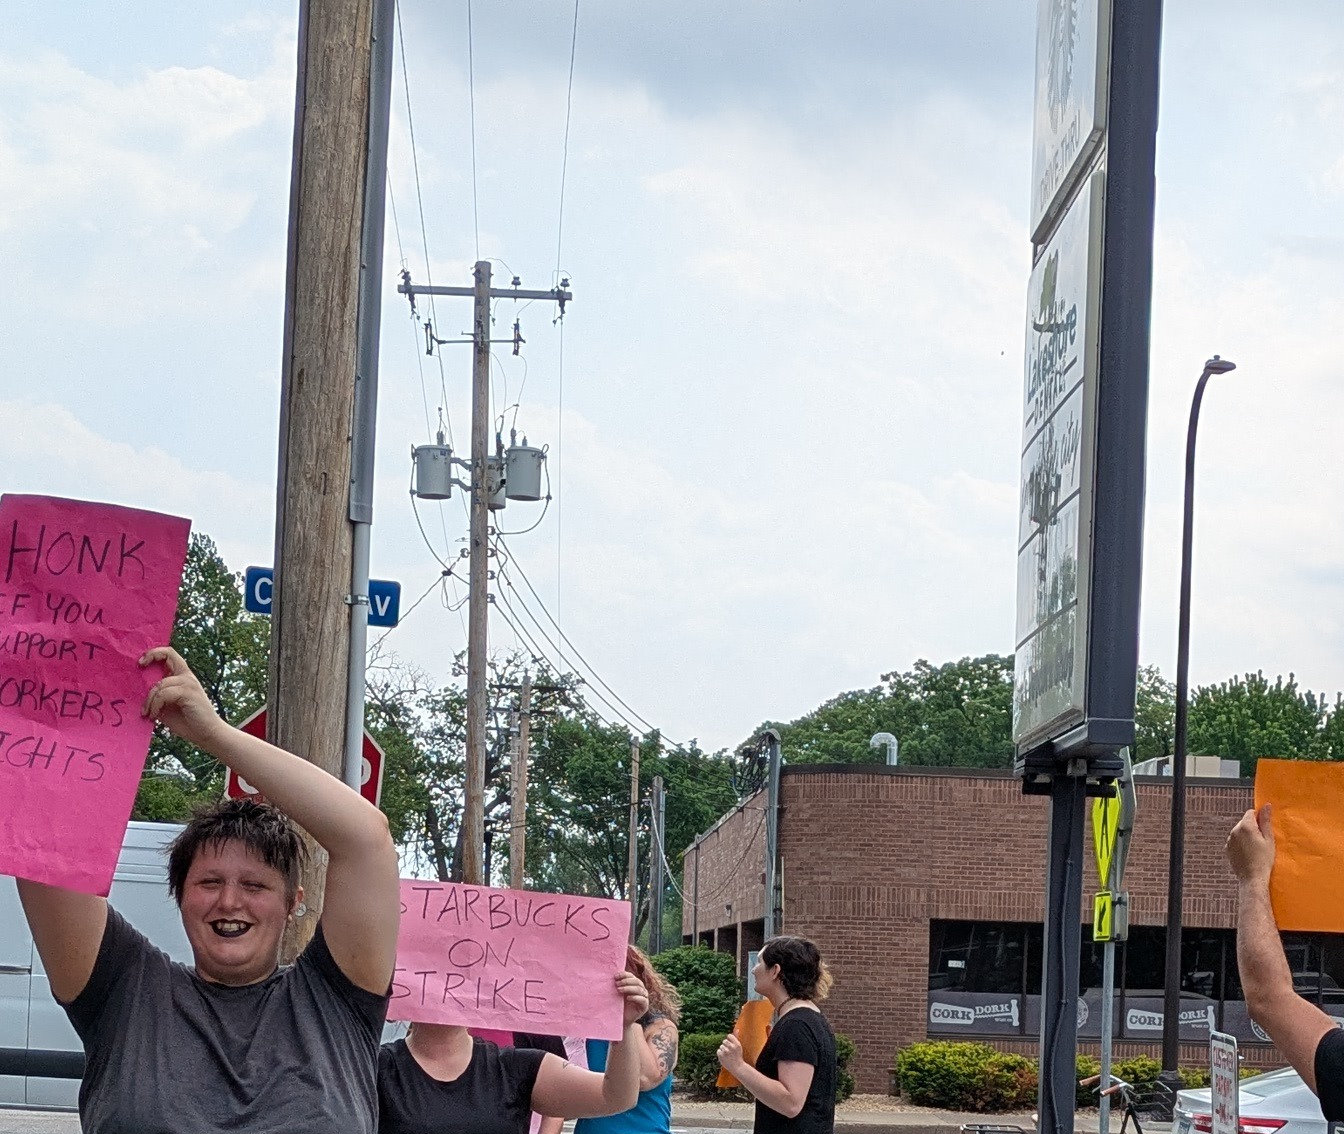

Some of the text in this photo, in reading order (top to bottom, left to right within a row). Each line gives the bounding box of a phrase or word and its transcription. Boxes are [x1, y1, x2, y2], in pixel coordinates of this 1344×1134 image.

[5, 519, 146, 584] HONK
[46, 592, 104, 625] YOU
[448, 937, 515, 968] ON
[932, 1003, 1010, 1021] CORK DORK
[1179, 1009, 1206, 1019] ORK
